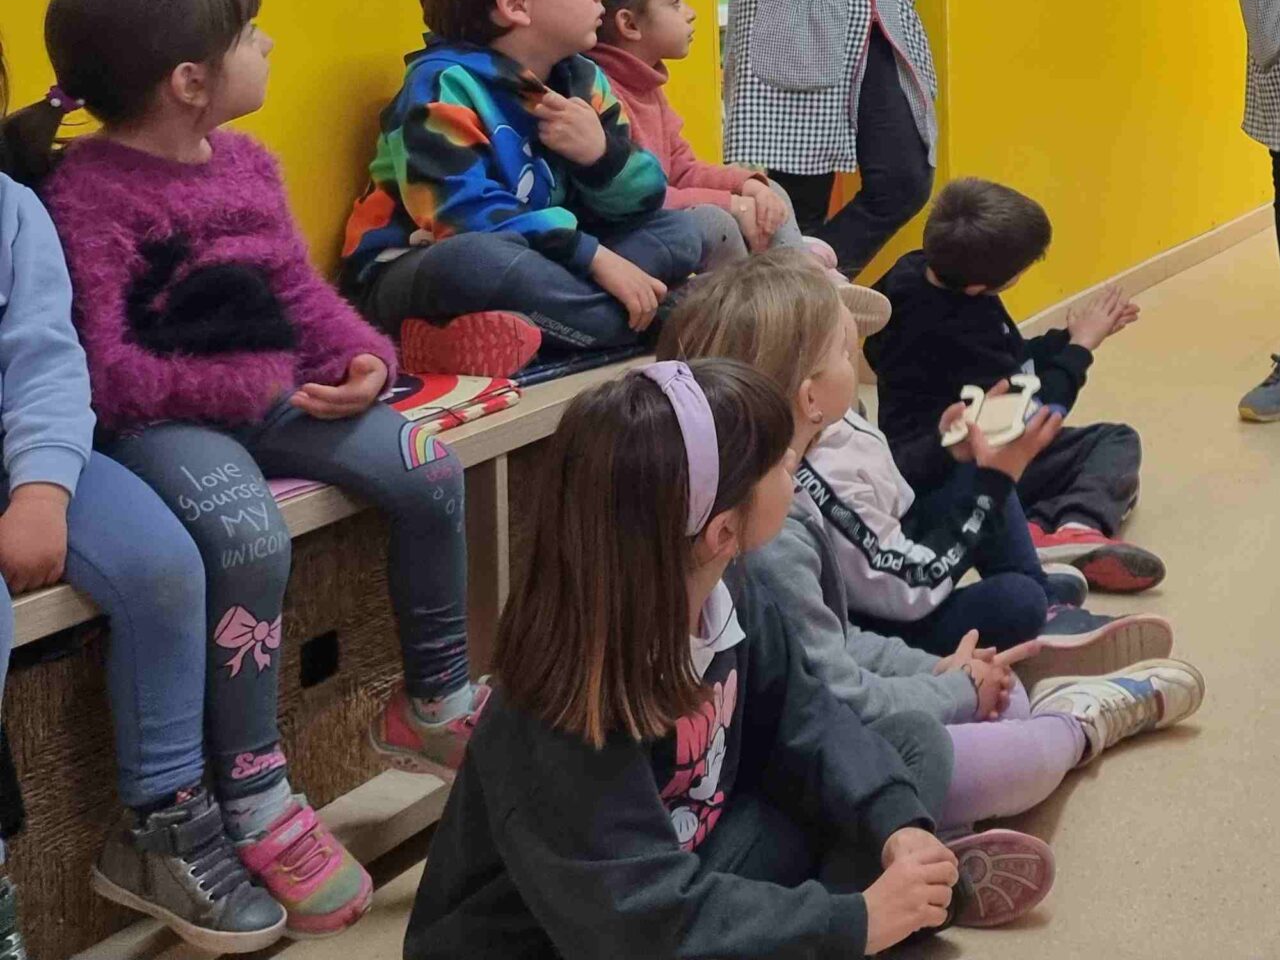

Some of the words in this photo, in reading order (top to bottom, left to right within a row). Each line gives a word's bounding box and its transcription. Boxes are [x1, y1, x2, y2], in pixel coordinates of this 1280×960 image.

[180, 463, 242, 492] love
[178, 474, 266, 521] yourse
[220, 501, 269, 538] MY
[222, 531, 290, 569] UNICO
